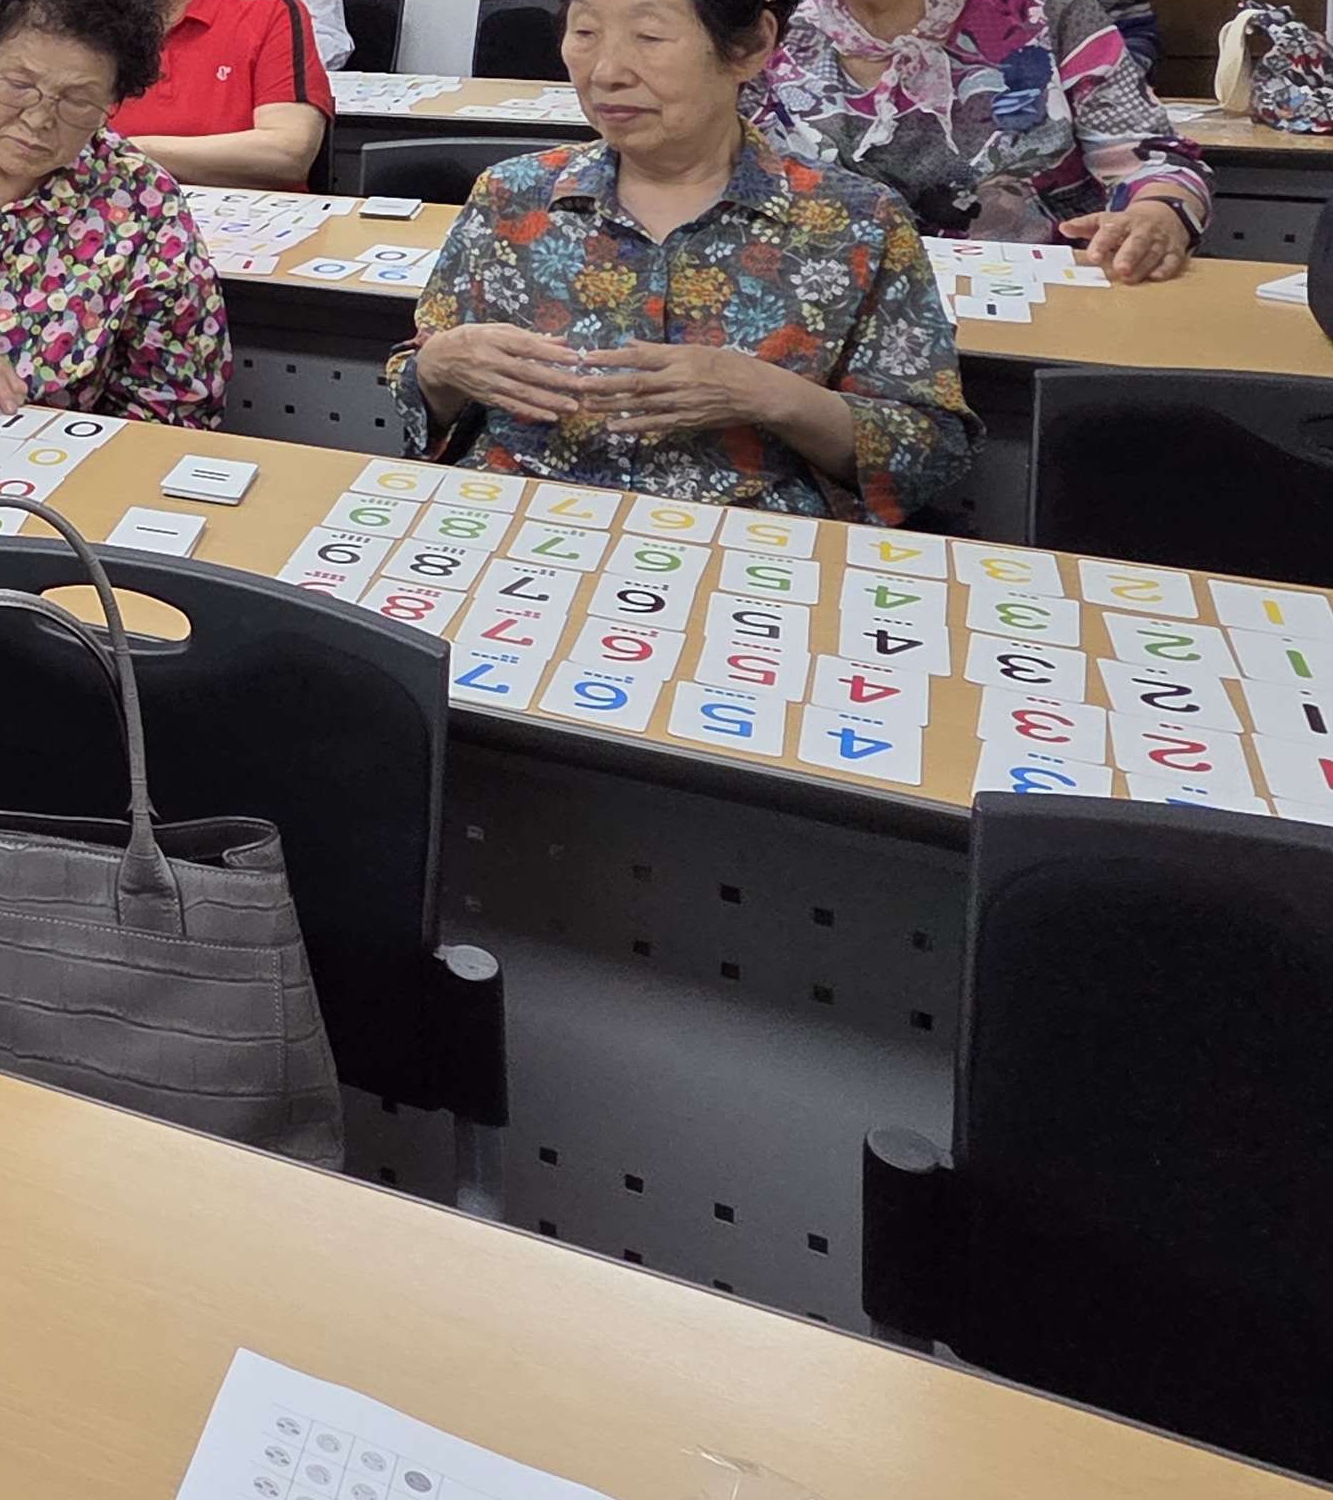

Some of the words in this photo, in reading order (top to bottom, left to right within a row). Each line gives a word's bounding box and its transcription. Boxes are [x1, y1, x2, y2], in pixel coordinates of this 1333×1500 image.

[64, 421, 103, 437] 0
[28, 449, 68, 465] 0
[459, 482, 502, 501] 8
[548, 498, 592, 518] 7
[438, 518, 487, 538] 8
[747, 524, 790, 547] 5
[531, 537, 579, 559] 7
[870, 541, 922, 562] 4
[409, 554, 461, 576] 8
[980, 559, 1030, 582] 3
[498, 577, 549, 601] 7
[746, 566, 793, 591] 5
[1108, 575, 1162, 601] 2
[381, 595, 435, 621] 8
[864, 586, 921, 609] 4
[732, 611, 782, 639] 5
[995, 603, 1051, 630] 3
[481, 619, 533, 646] 7
[863, 629, 923, 655] 4
[1136, 630, 1201, 661] 2
[454, 664, 509, 694] 7
[727, 655, 780, 686] 5
[996, 654, 1056, 683] 3
[838, 675, 901, 703] 4
[1131, 678, 1200, 712] 2
[700, 703, 756, 738] 5
[1011, 710, 1074, 743] 3
[827, 728, 893, 759] 4
[1142, 733, 1212, 772] 2
